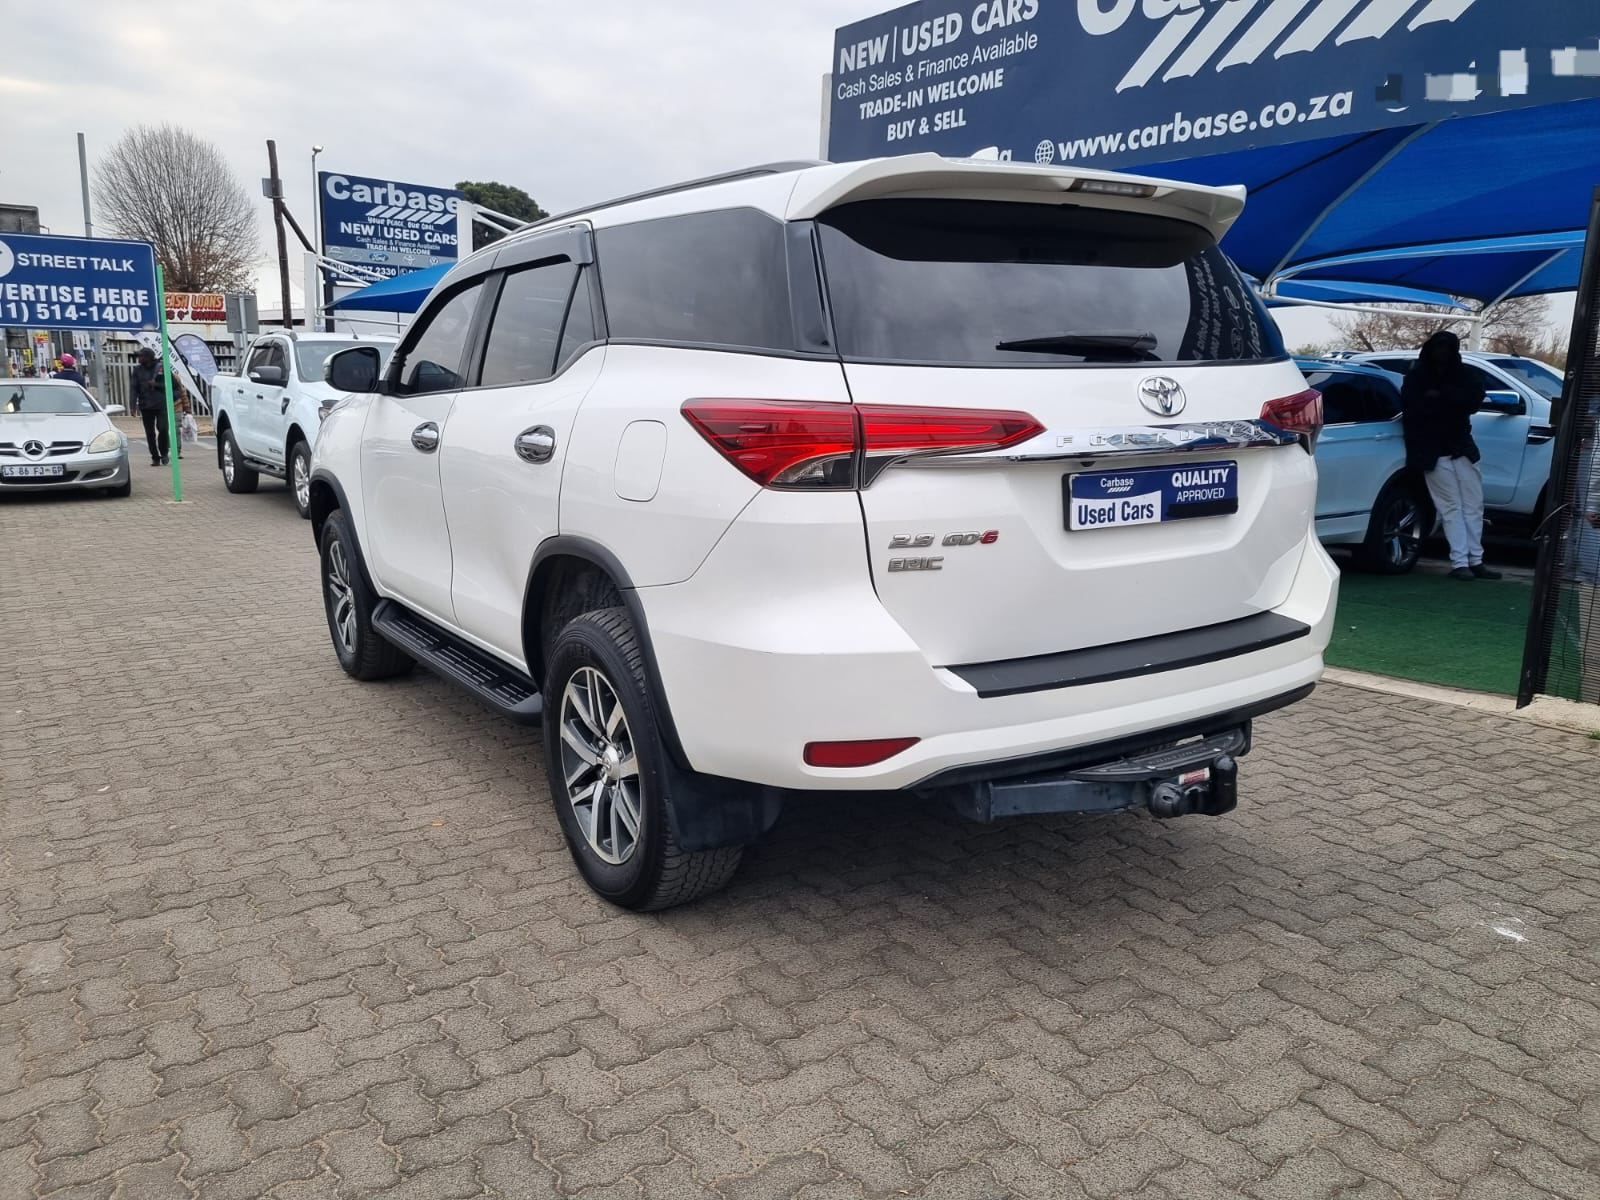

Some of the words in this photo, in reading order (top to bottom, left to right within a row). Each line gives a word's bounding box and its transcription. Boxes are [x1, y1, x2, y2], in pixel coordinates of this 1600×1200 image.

[839, 34, 889, 74] NEW
[902, 12, 963, 56] USED
[971, 0, 1039, 35] CARS
[837, 77, 866, 100] Cash
[868, 71, 902, 91] Sales
[905, 64, 914, 83] &
[917, 53, 969, 79] Finance
[971, 31, 1038, 65] Available
[859, 89, 923, 120] TRADE-IN
[927, 68, 1004, 104] WELCOME
[887, 119, 916, 141] BUY
[918, 117, 930, 135] &
[933, 108, 967, 132] SELL
[1058, 90, 1353, 161] www.carbase.co.za
[326, 175, 460, 214] Carbase
[340, 221, 375, 236] NEW
[384, 226, 420, 241] USED
[424, 231, 457, 246] CARS
[399, 247, 431, 256] WELCOME
[17, 253, 87, 270] STREET
[90, 257, 135, 273] TALK
[93, 287, 149, 306] HERE
[164, 294, 189, 309] CASH
[191, 295, 223, 310] LOANS
[36, 303, 142, 323] 514-1400
[1100, 478, 1134, 488] Carbase
[1171, 468, 1229, 488] QUALITY
[1176, 488, 1225, 502] APPROVED
[1078, 503, 1115, 526] Used
[1121, 501, 1154, 521] Cars
[888, 556, 944, 572] EPIC
